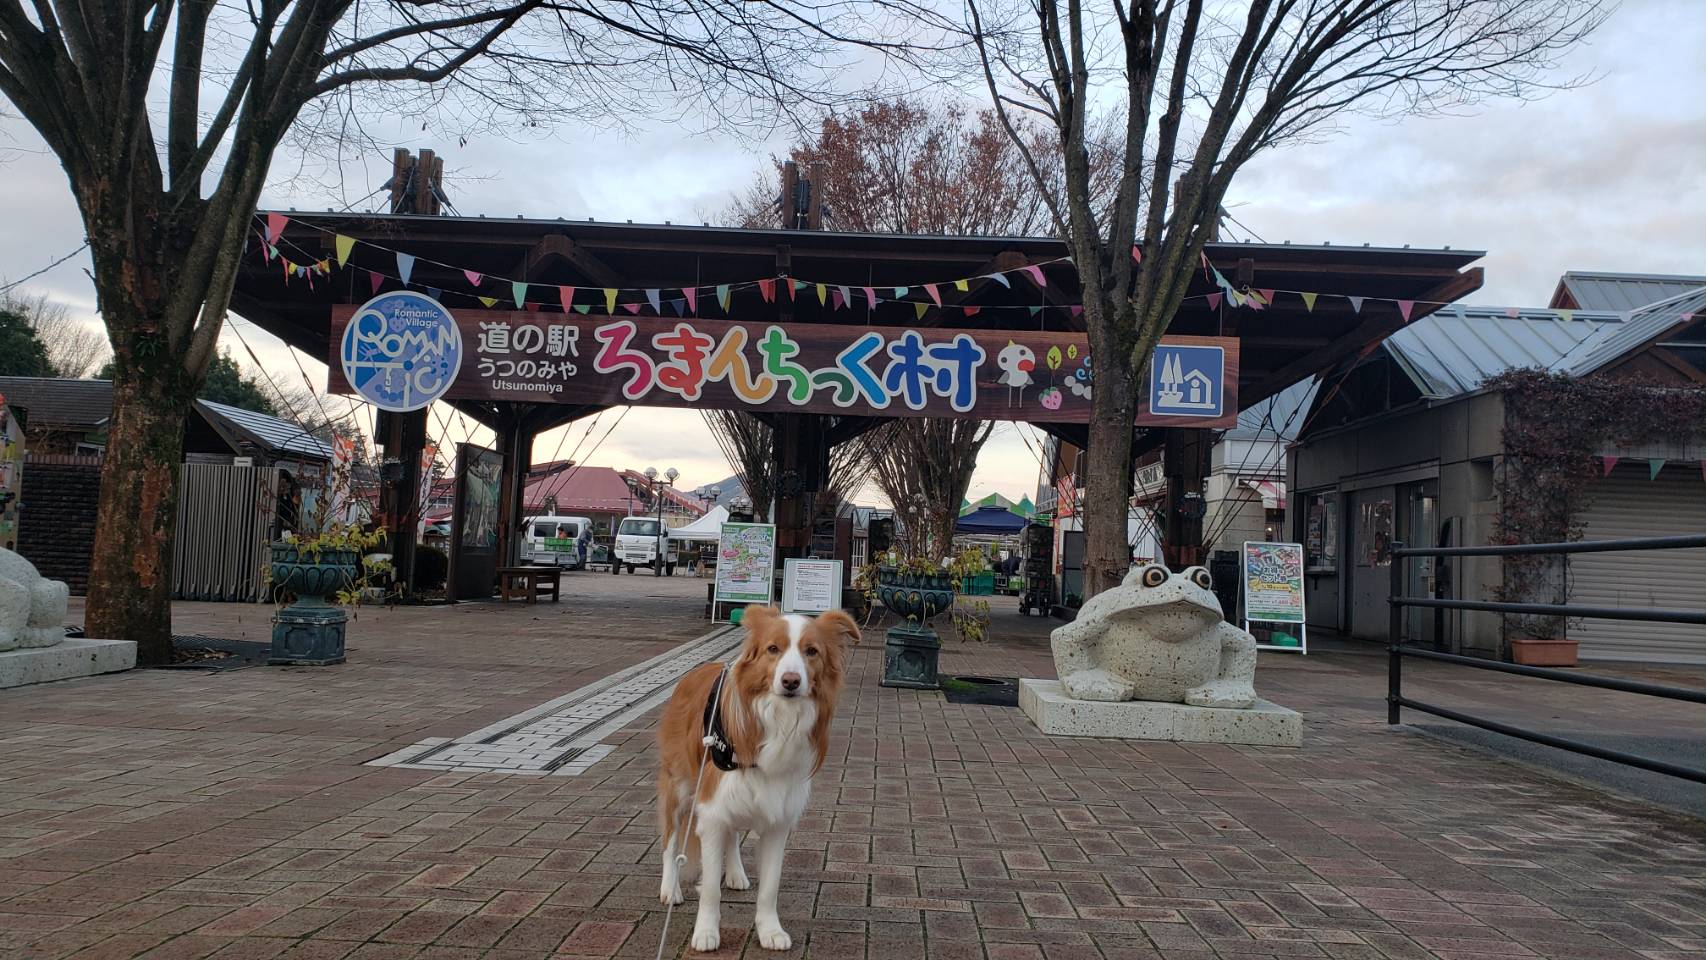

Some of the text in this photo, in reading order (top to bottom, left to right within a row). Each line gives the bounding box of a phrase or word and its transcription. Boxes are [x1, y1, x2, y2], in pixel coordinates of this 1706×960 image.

[394, 308, 439, 319] Romantic
[405, 318, 439, 329] Village
[477, 321, 580, 357] 道の駅
[477, 357, 577, 380] うつのみや
[593, 321, 986, 412] ろまんちっく村
[492, 379, 564, 393] Utsunomiya
